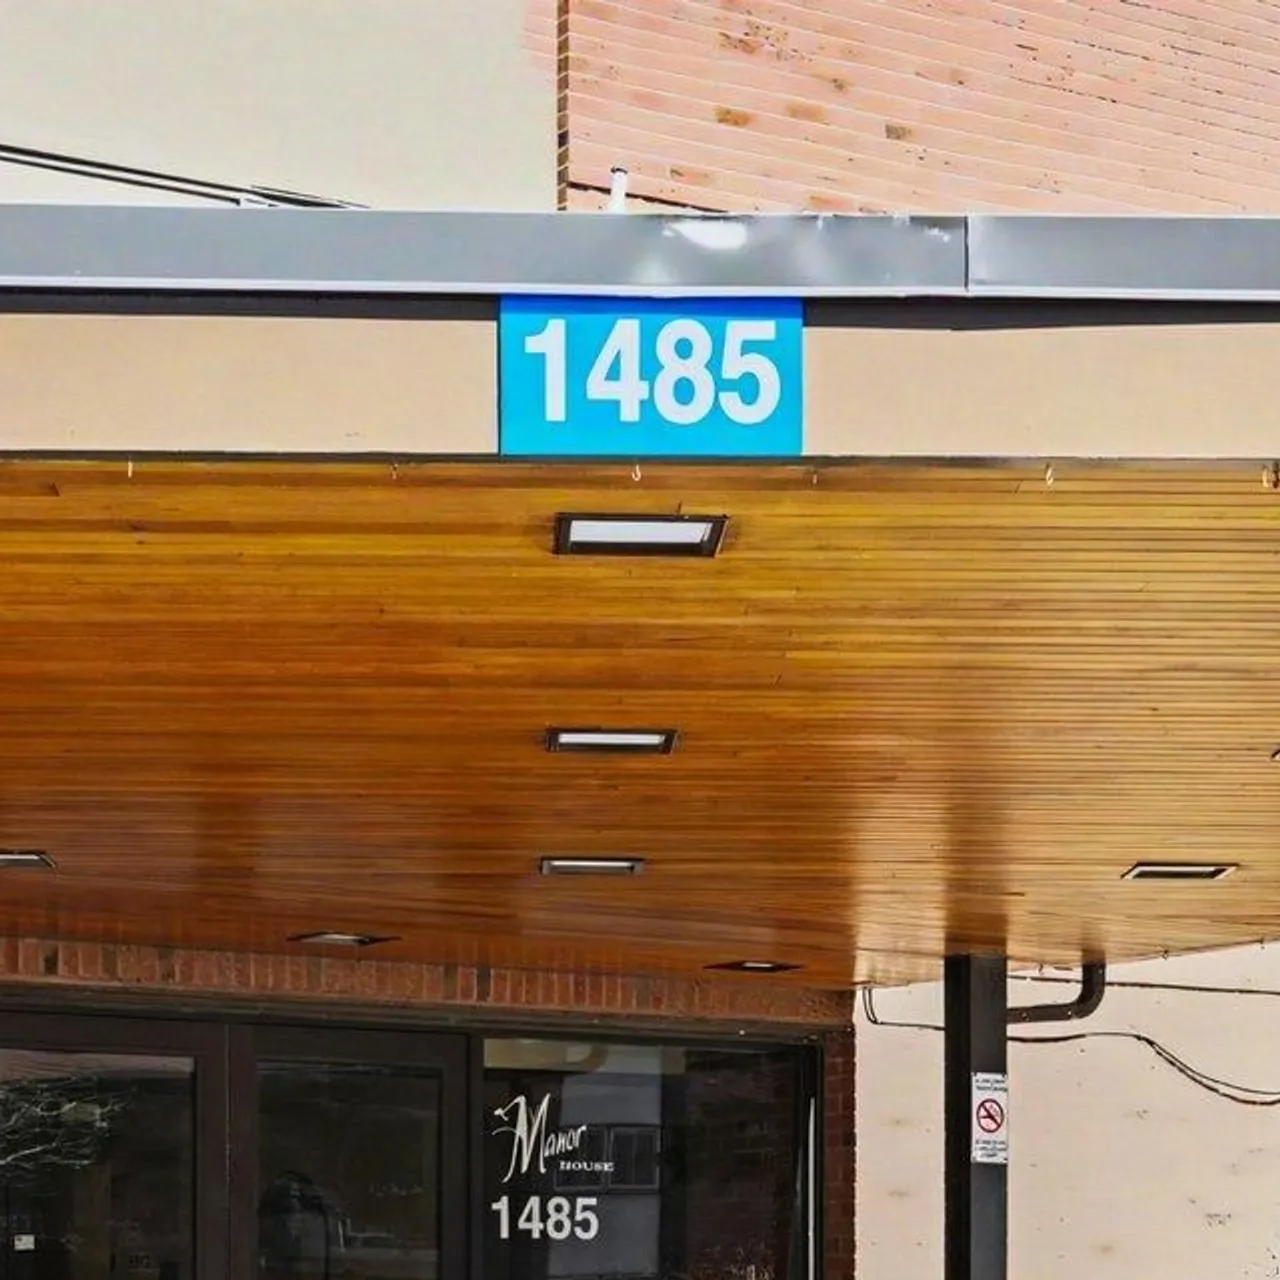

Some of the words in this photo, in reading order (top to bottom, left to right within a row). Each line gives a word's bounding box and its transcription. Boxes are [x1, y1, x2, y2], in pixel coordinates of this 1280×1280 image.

[524, 318, 781, 425] 1485
[492, 1092, 587, 1184] Manor
[559, 1159, 615, 1172] HOUSE
[491, 1195, 599, 1240] 1485
